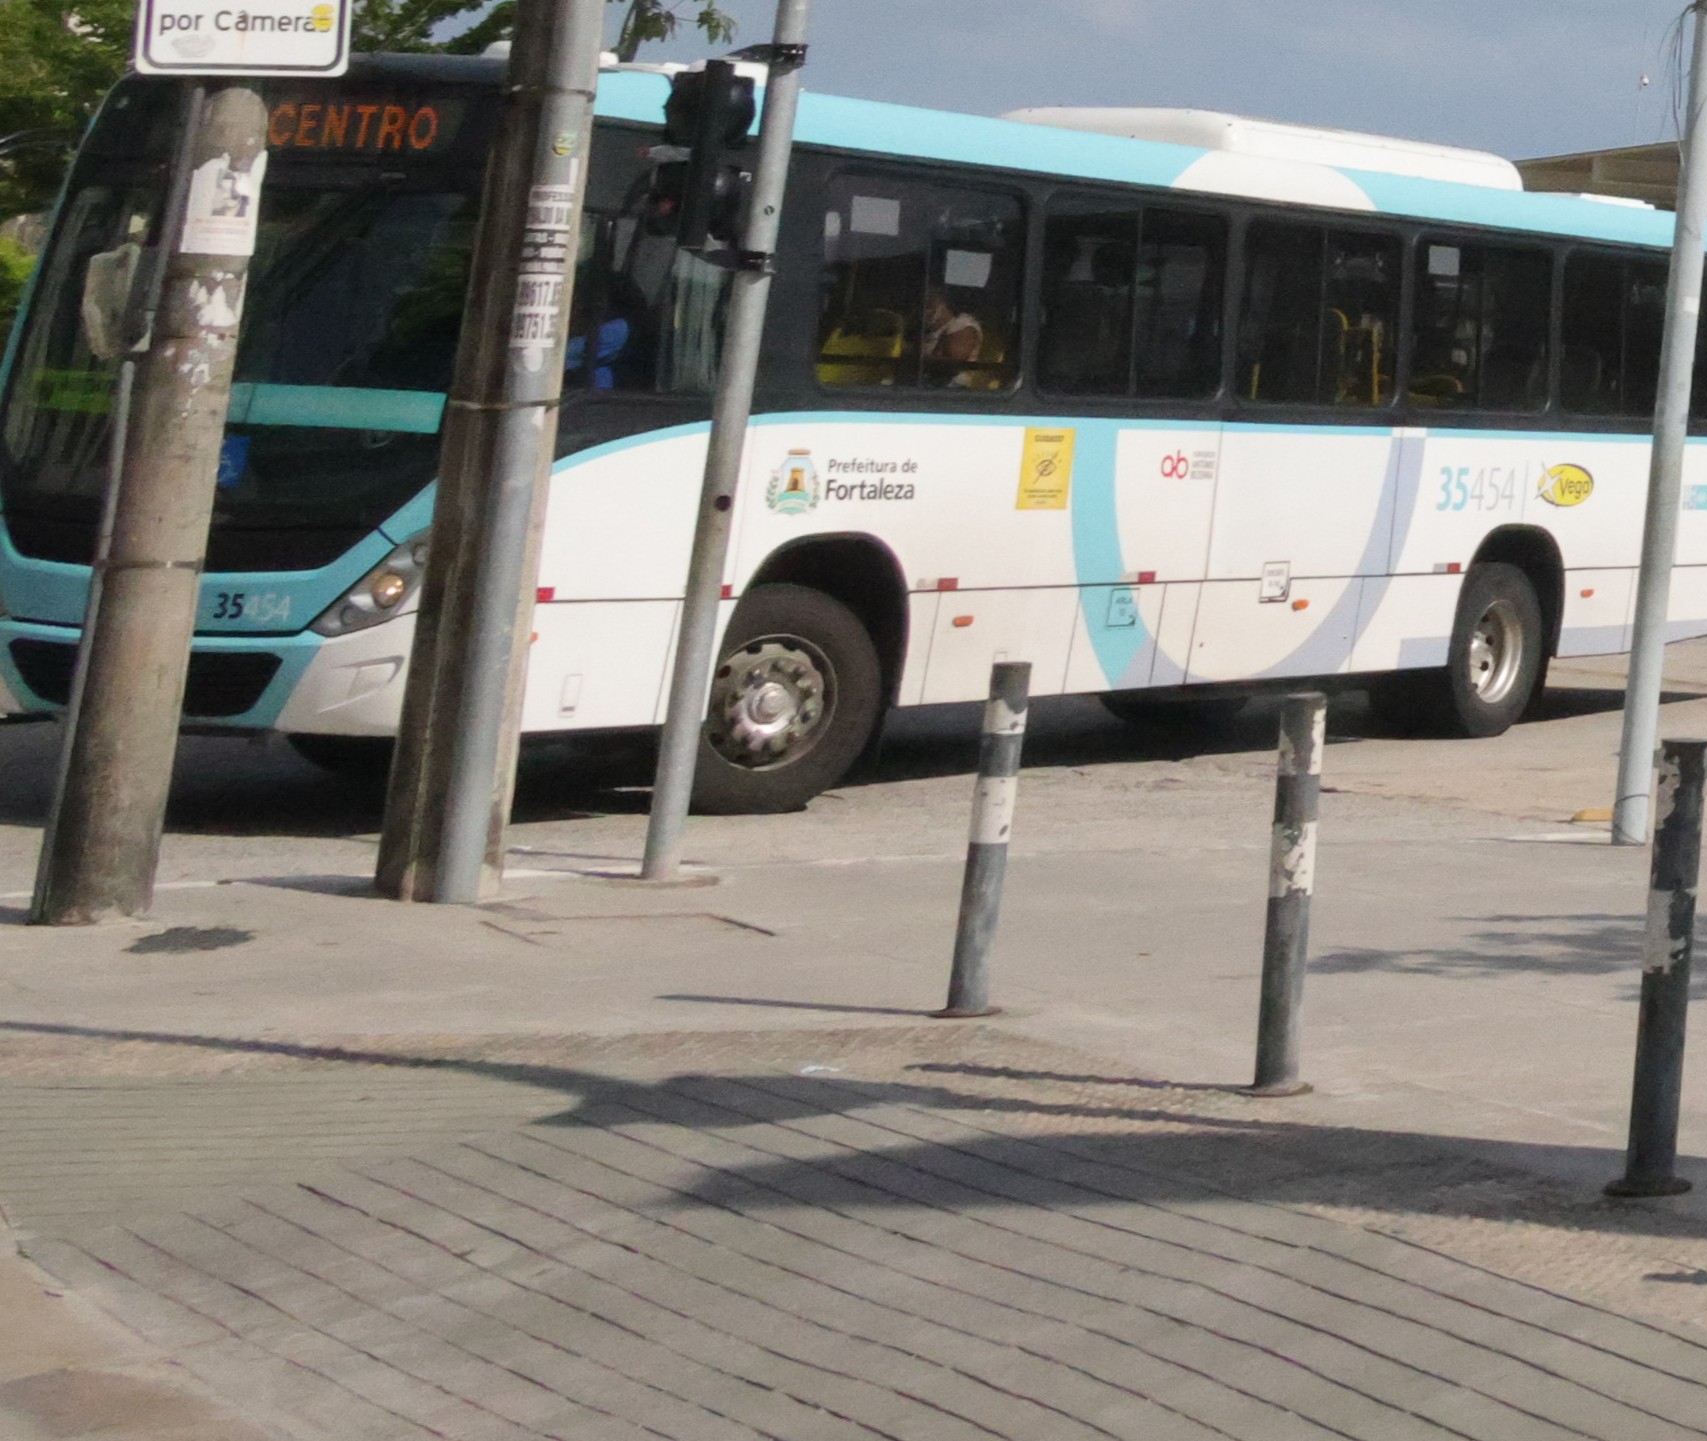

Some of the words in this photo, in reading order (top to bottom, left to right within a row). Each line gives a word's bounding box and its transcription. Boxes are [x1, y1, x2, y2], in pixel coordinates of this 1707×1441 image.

[158, 13, 204, 36] por
[215, 10, 331, 33] Câmera
[269, 103, 439, 150] CENTRO
[828, 458, 898, 473] Prefeitura
[901, 458, 918, 473] de
[824, 477, 916, 500] Fortaleza
[1435, 466, 1516, 511] 35454
